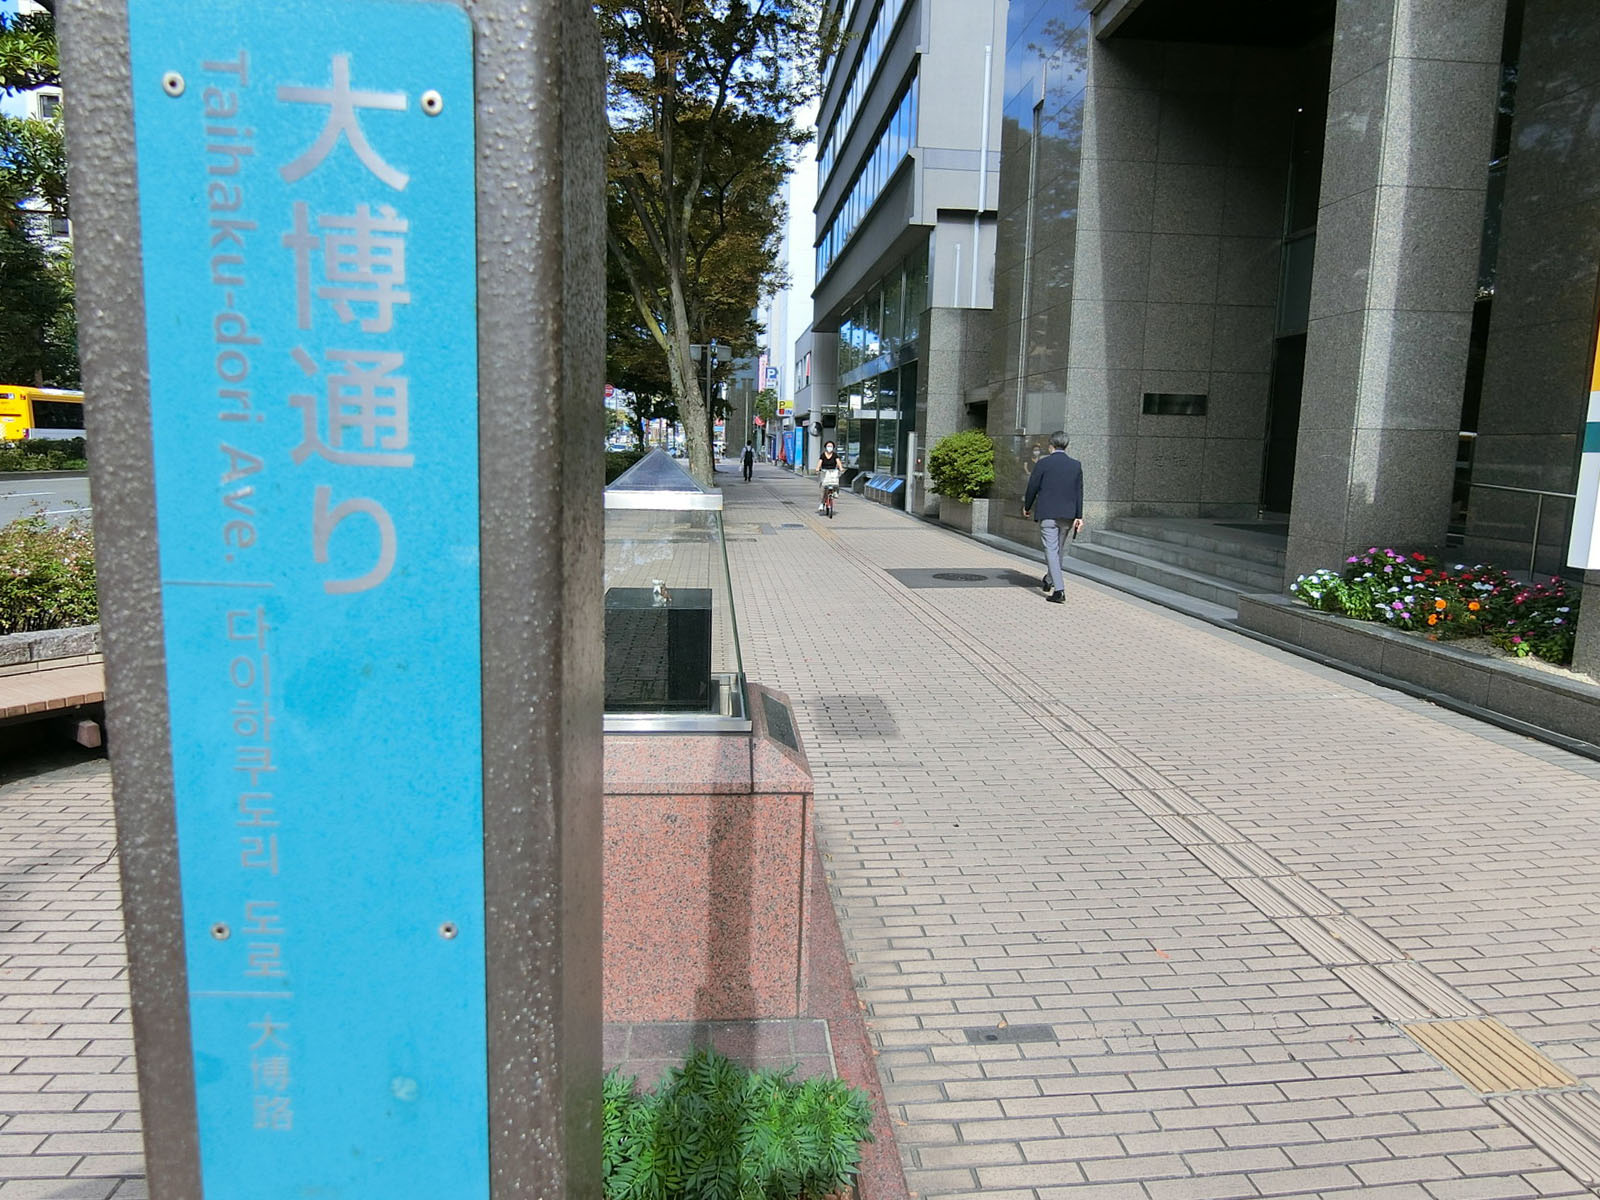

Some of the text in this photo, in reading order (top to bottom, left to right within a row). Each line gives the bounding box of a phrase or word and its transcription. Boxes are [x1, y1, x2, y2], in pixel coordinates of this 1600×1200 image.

[201, 49, 265, 563] Taihaku-dori Ave.
[277, 54, 414, 594] 大博通り
[227, 606, 287, 978] 다이하쿠도리 도로
[248, 1011, 293, 1131] 大博路
